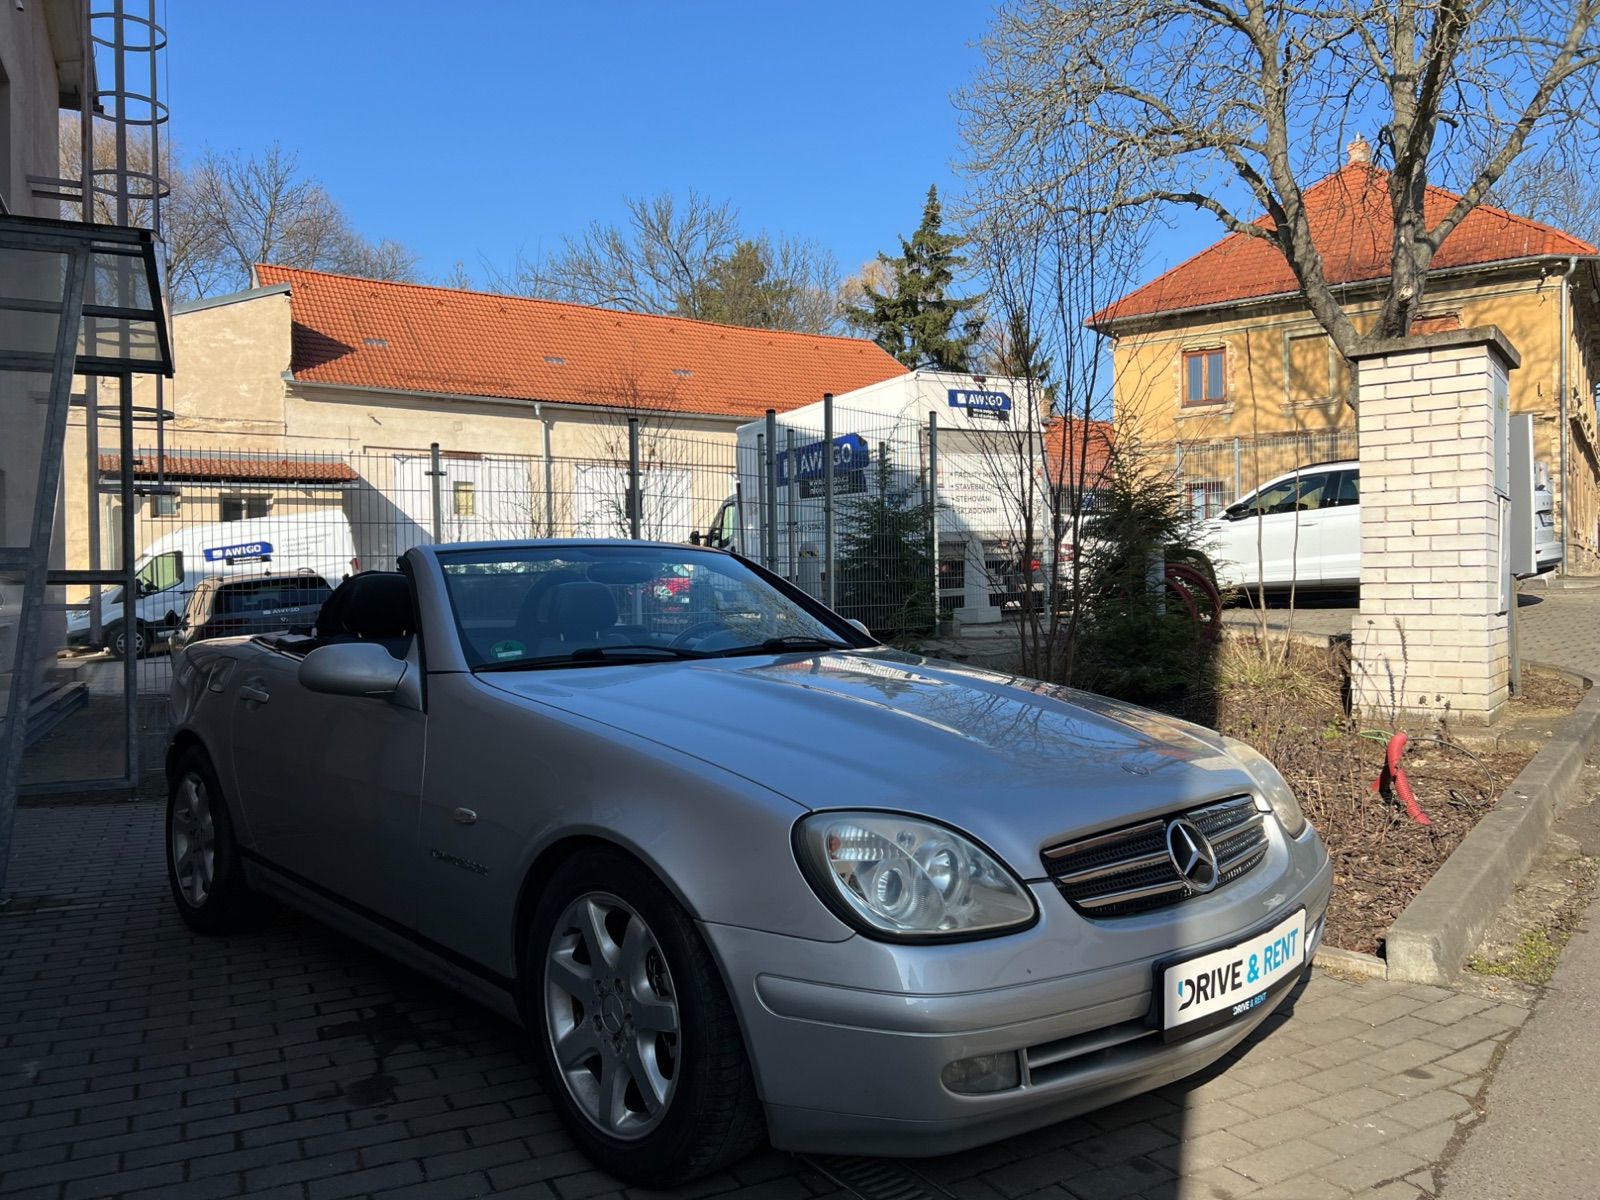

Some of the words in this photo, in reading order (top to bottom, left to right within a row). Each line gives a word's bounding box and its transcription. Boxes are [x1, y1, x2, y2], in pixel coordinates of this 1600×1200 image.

[800, 443, 852, 474] AWGO
[225, 544, 261, 557] AWIGO
[1178, 959, 1243, 1011] DRIVE
[1247, 953, 1260, 983] &
[1263, 927, 1299, 976] RENT
[1232, 1002, 1250, 1015] DRIVE
[1254, 992, 1267, 1006] RENT
